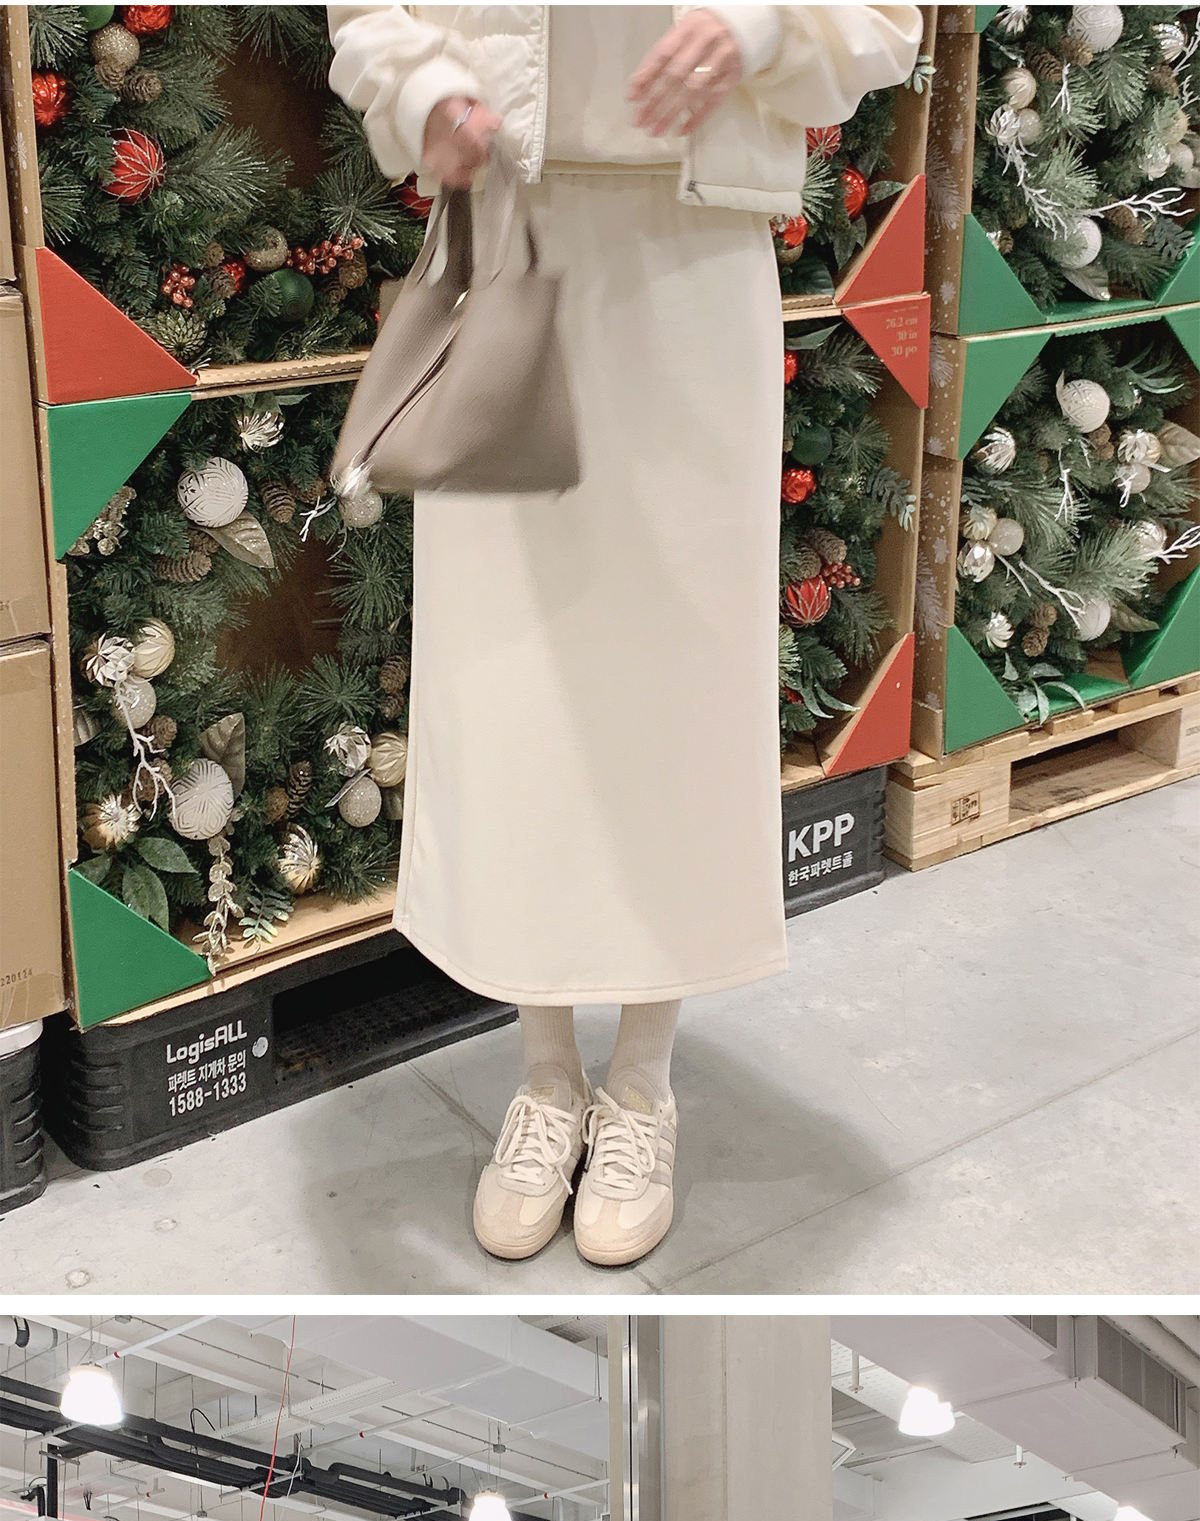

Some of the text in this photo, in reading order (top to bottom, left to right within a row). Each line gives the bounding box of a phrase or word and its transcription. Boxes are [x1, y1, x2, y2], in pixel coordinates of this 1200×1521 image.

[788, 812, 855, 864] KPP
[788, 851, 854, 887] 한국파렛트풀
[166, 1020, 248, 1065] LogisALL
[168, 1049, 246, 1093] 파렛트 지게차 문의
[169, 1071, 247, 1117] 1588-1333
